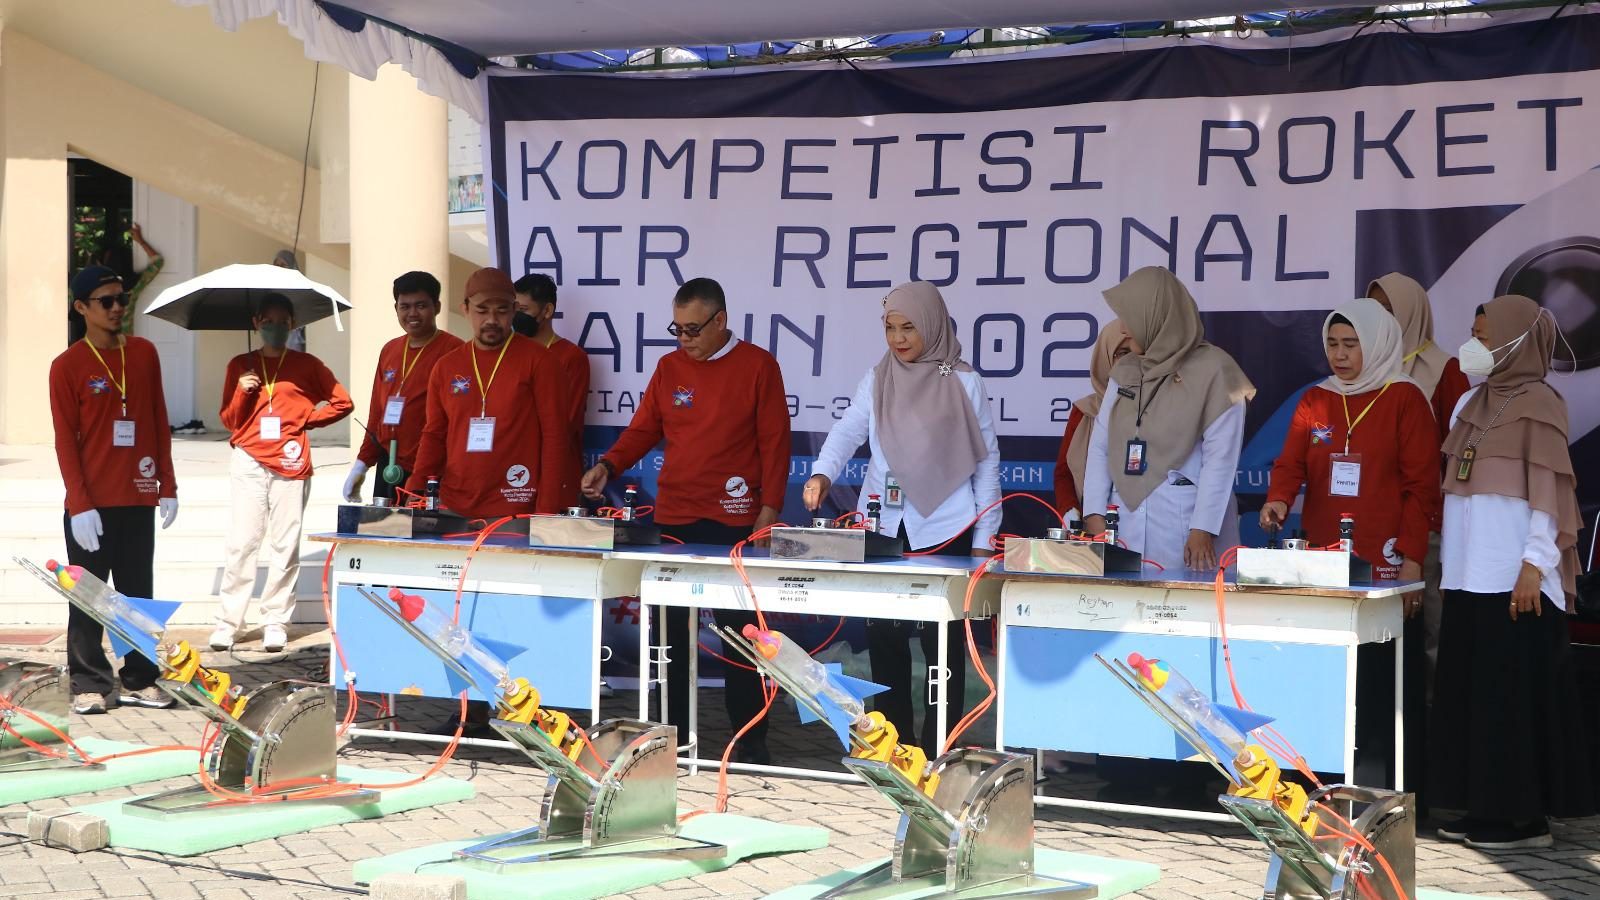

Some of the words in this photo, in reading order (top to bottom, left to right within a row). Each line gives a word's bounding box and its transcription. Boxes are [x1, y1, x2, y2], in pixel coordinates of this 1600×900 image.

[520, 125, 1106, 201] KOMPETISI
[1198, 97, 1583, 187] ROKET
[523, 225, 691, 287] AIR
[772, 214, 1329, 289] REGIONAL
[349, 557, 361, 570] 03
